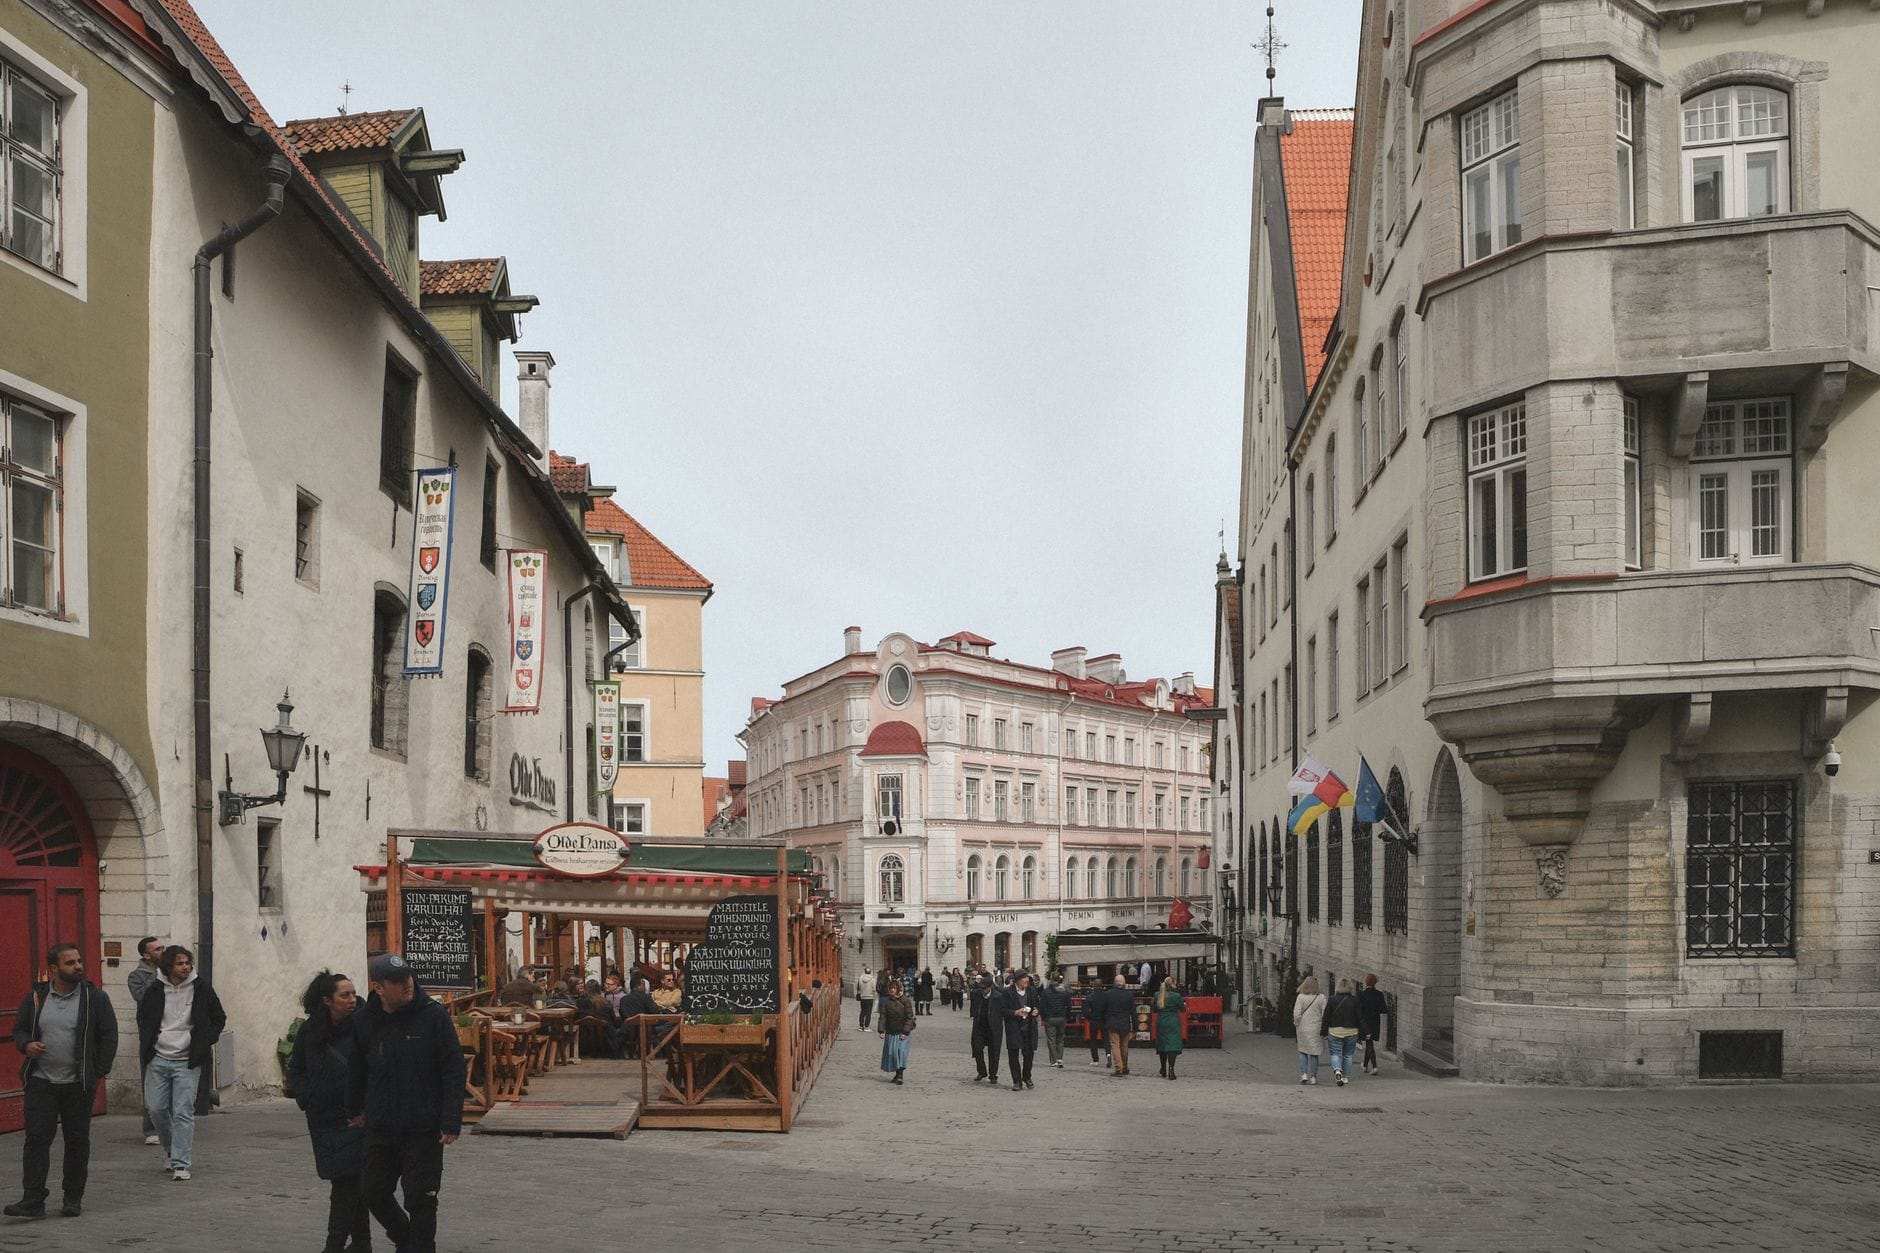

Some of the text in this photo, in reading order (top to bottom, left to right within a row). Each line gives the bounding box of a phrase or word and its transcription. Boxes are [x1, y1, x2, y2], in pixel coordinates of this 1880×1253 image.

[547, 833, 617, 850] Olde Hansa
[716, 903, 768, 913] MAITSETELE
[989, 913, 1018, 923] DEMINI
[1068, 911, 1094, 920] DEMINI
[1111, 909, 1135, 918] DEMINI
[692, 983, 768, 992] LOCAL GAME
